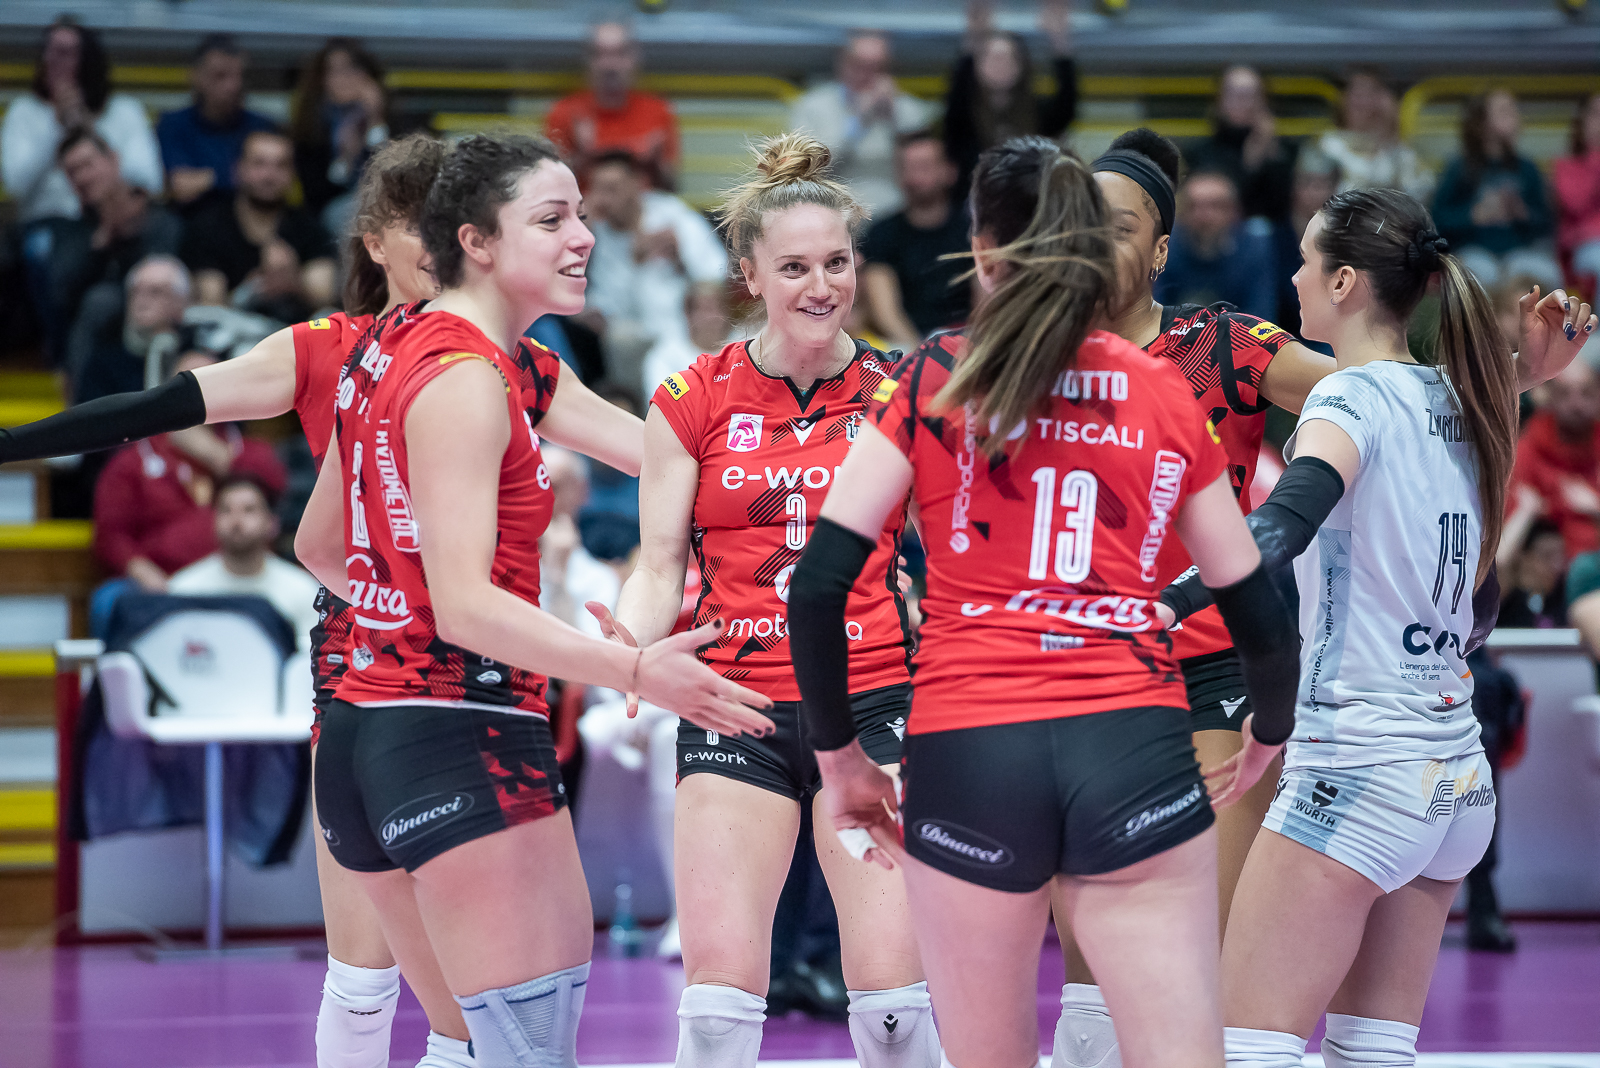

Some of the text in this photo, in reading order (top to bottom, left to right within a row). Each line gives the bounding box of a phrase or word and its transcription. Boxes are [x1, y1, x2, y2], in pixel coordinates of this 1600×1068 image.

[1036, 417, 1145, 450] TISCALI
[785, 493, 807, 550] 3
[1028, 467, 1099, 584] 13
[1432, 512, 1468, 615] 14
[684, 751, 748, 766] e-work
[381, 796, 464, 846] Dinacci
[1295, 799, 1336, 828] WÜRTH
[920, 823, 1004, 863] Dinacci
